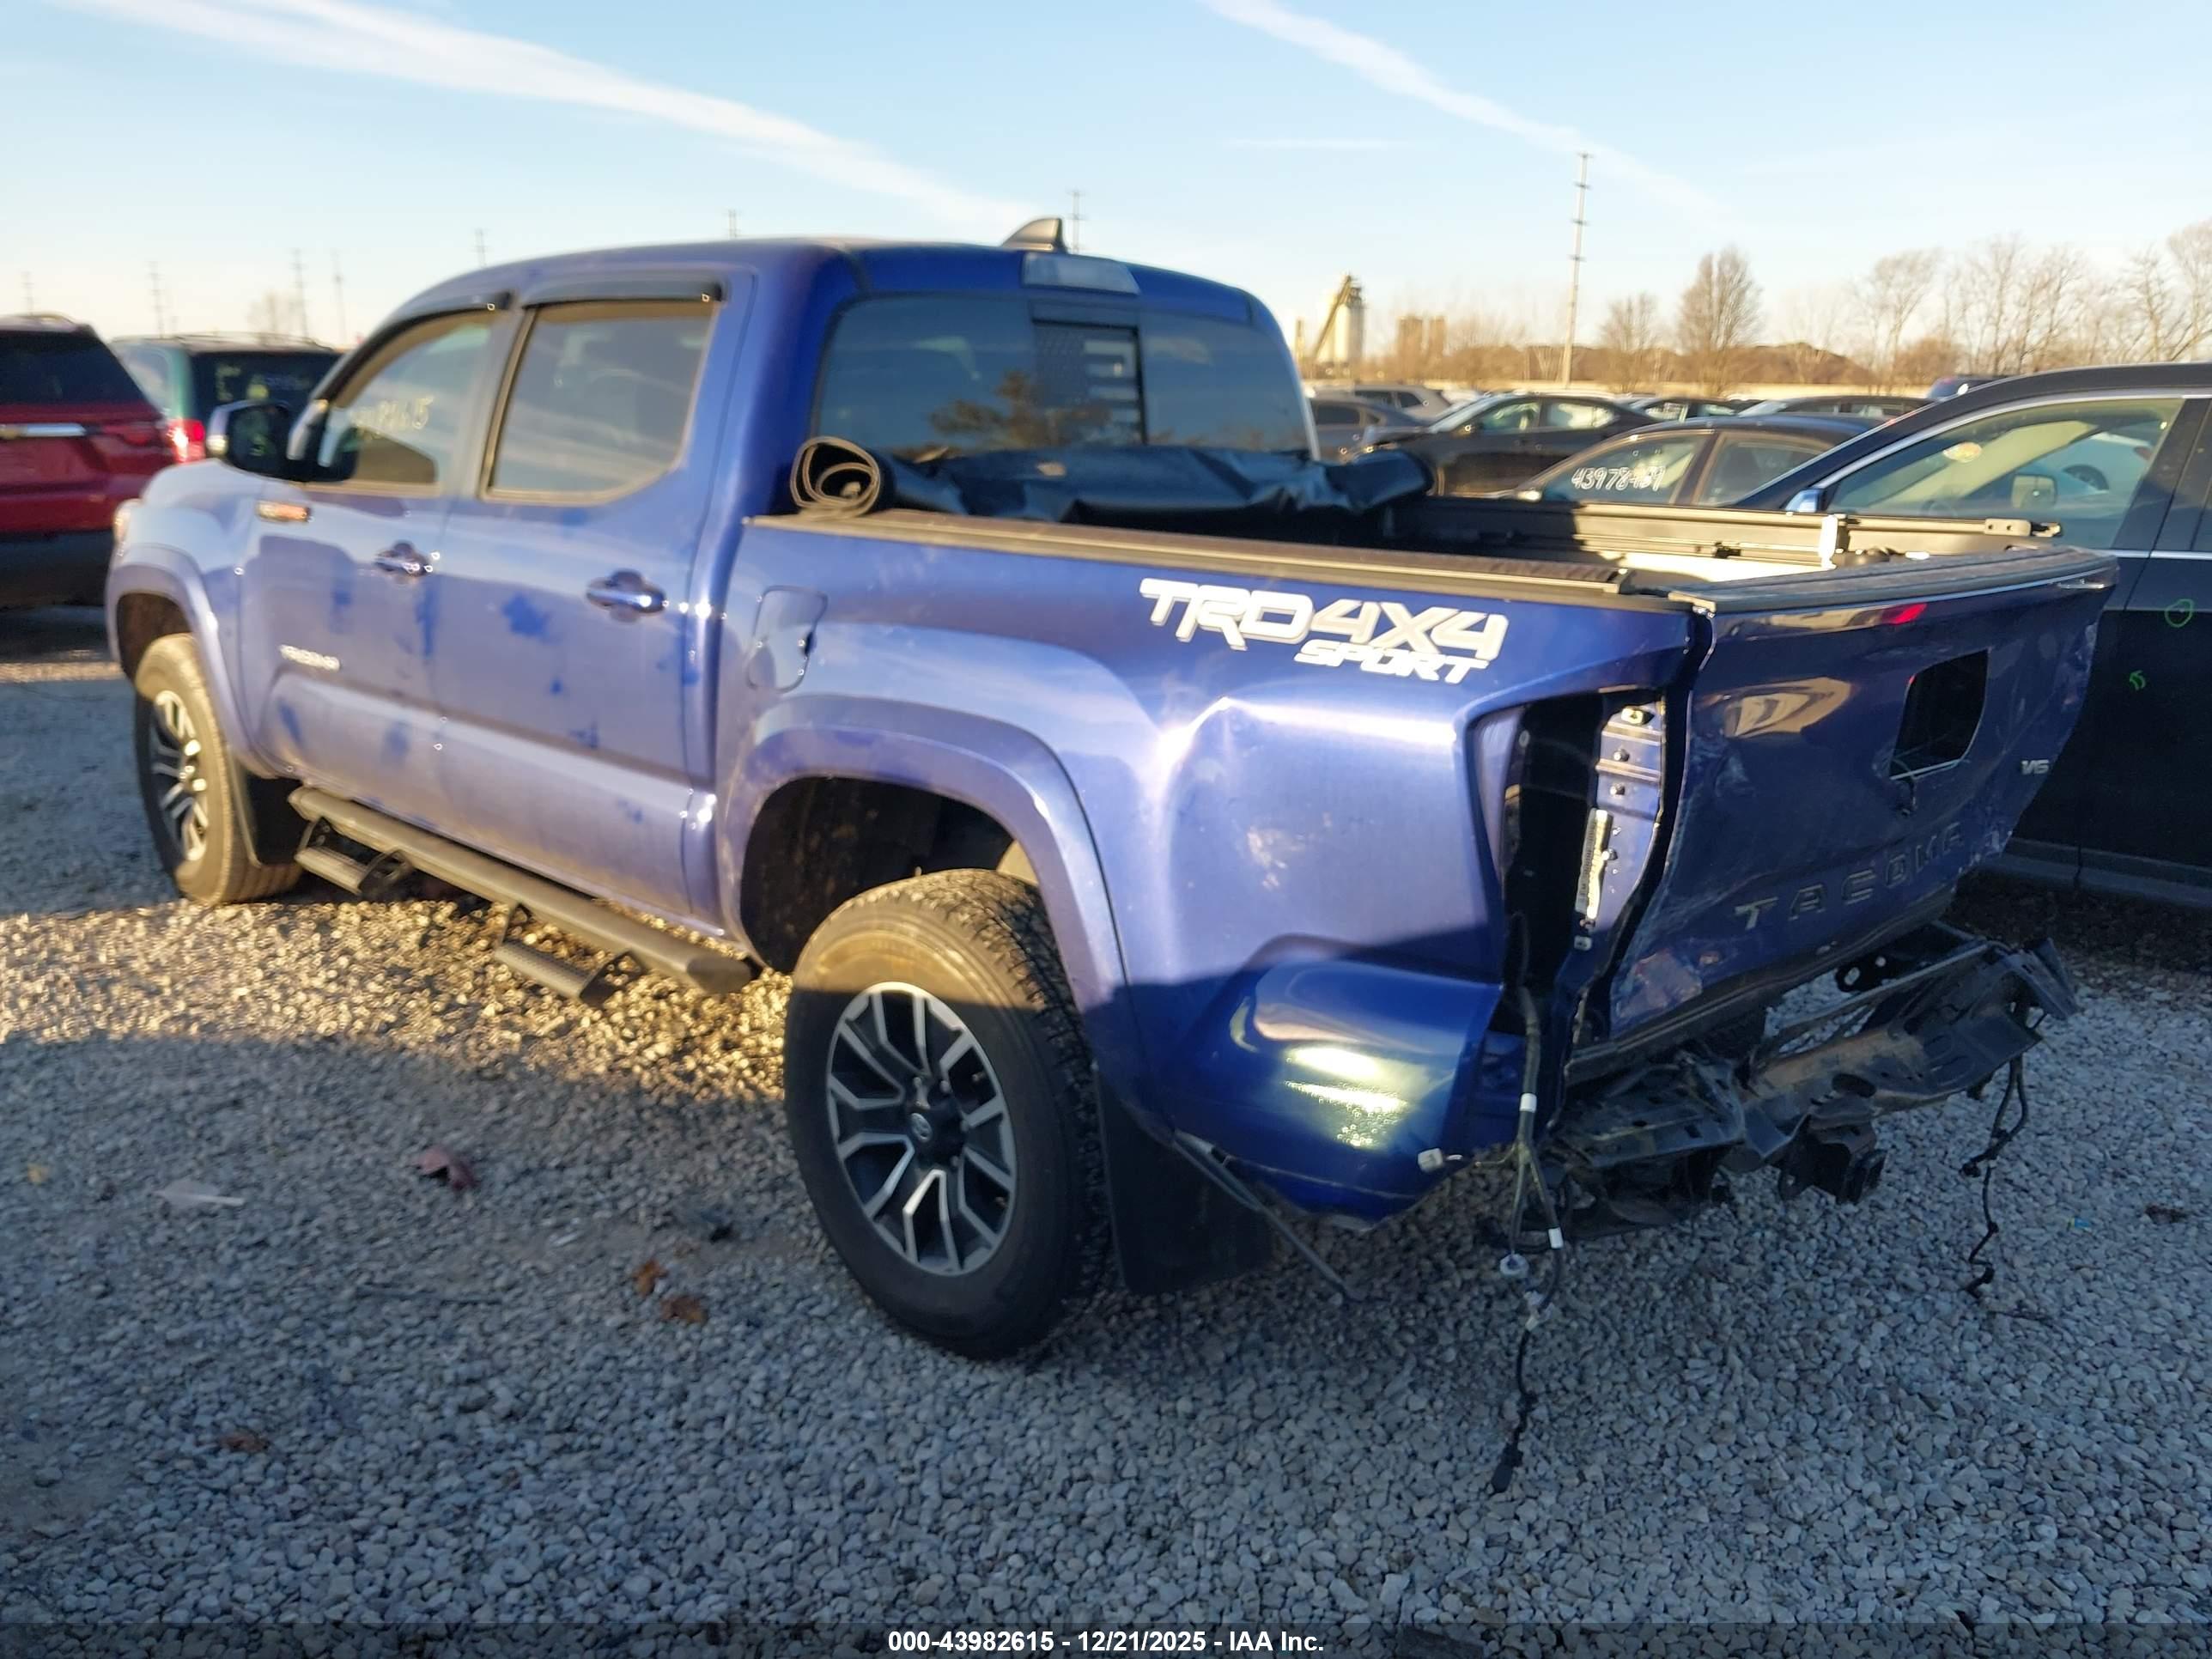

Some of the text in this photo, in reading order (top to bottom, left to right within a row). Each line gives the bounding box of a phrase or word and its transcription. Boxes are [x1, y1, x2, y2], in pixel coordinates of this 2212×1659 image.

[1139, 578, 1314, 651] TRD
[1293, 639, 1490, 684] SPORT
[2021, 759, 2050, 775] V6
